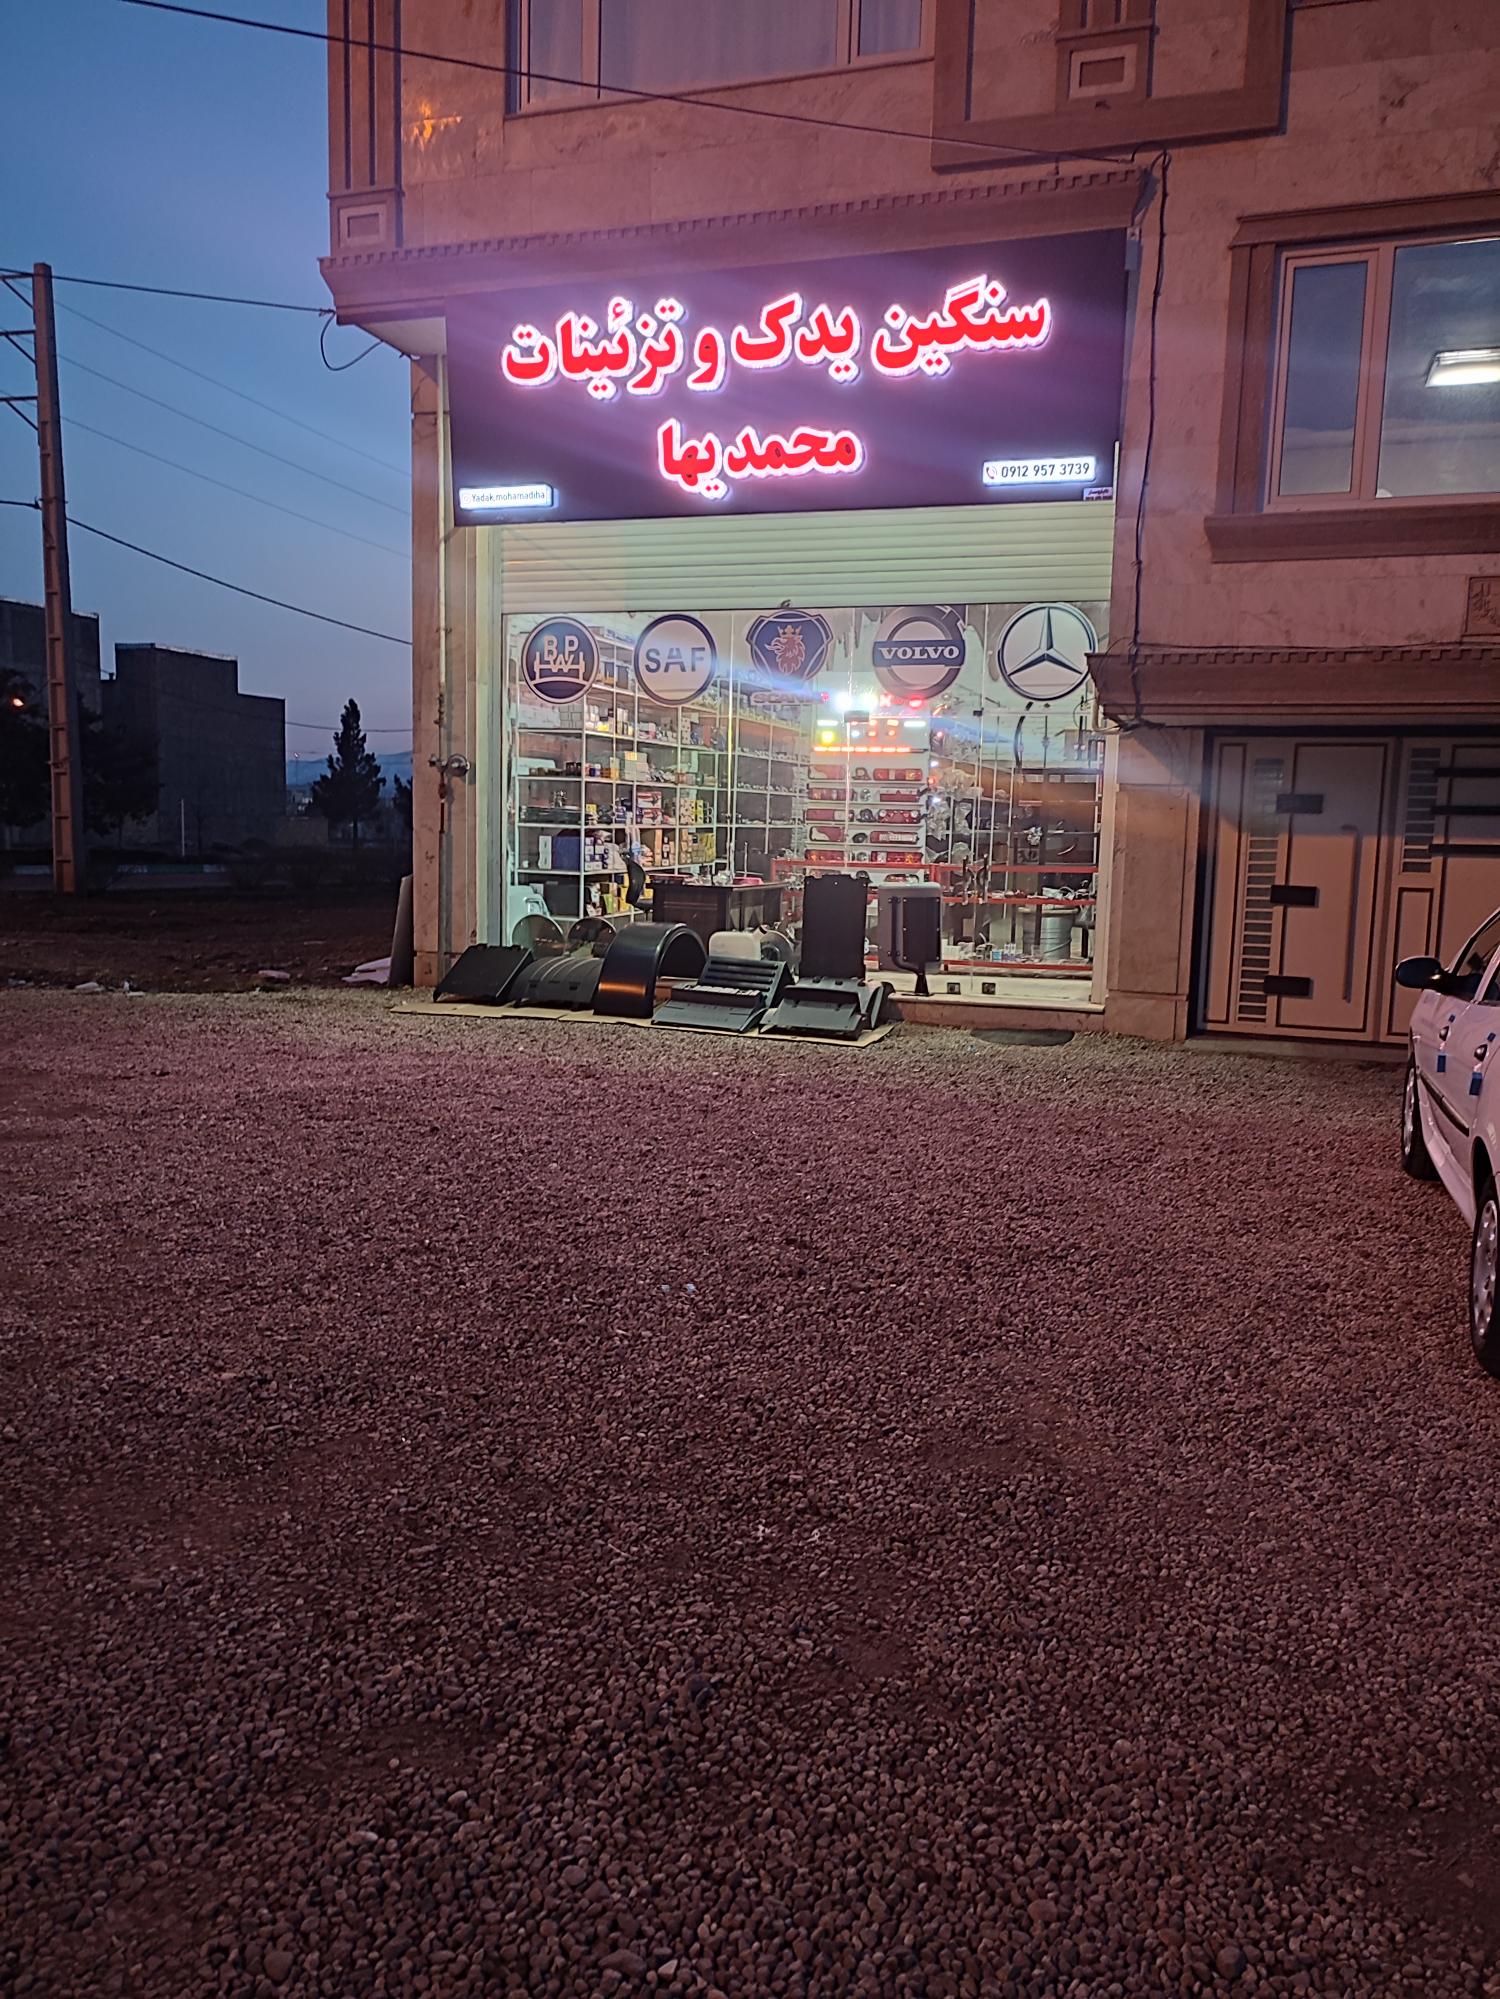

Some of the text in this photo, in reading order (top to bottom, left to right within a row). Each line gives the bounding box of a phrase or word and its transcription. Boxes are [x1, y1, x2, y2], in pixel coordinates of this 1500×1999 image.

[502, 275, 1051, 400] سنگین یدک و تزئینات
[658, 418, 864, 499] محمدیها
[1001, 462, 1090, 478] 0912 957 3739
[644, 646, 706, 674] SAF
[878, 645, 960, 660] VOLVO
